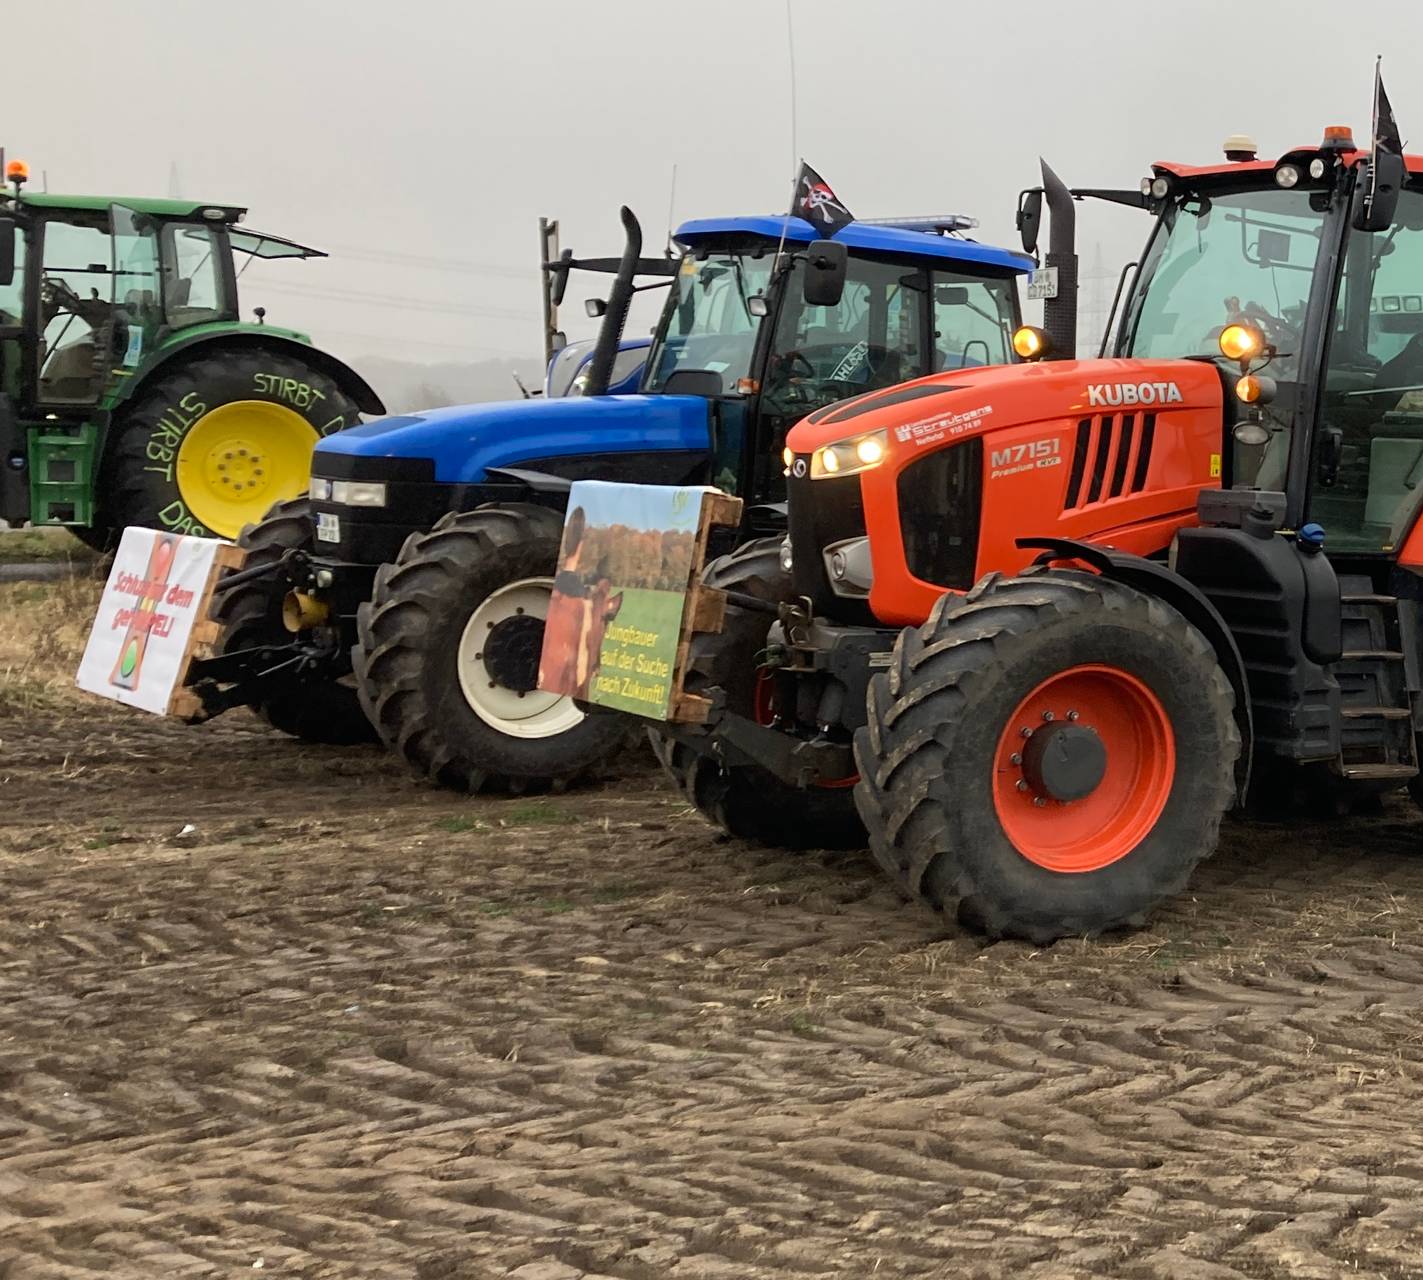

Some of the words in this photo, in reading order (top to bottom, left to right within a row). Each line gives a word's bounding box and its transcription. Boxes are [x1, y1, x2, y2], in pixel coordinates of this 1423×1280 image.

[253, 373, 326, 412] STIRBT
[1087, 382, 1184, 407] KUBOTA
[143, 391, 207, 482] STIRBT
[991, 438, 1060, 468] M7151
[990, 463, 1035, 479] Premium
[158, 500, 206, 537] DAS
[604, 621, 658, 648] Jungbauer
[600, 648, 619, 667] auf
[618, 651, 636, 670] der
[636, 653, 669, 678] Suche
[595, 676, 621, 694] nach
[621, 677, 665, 705] Zukunft!
